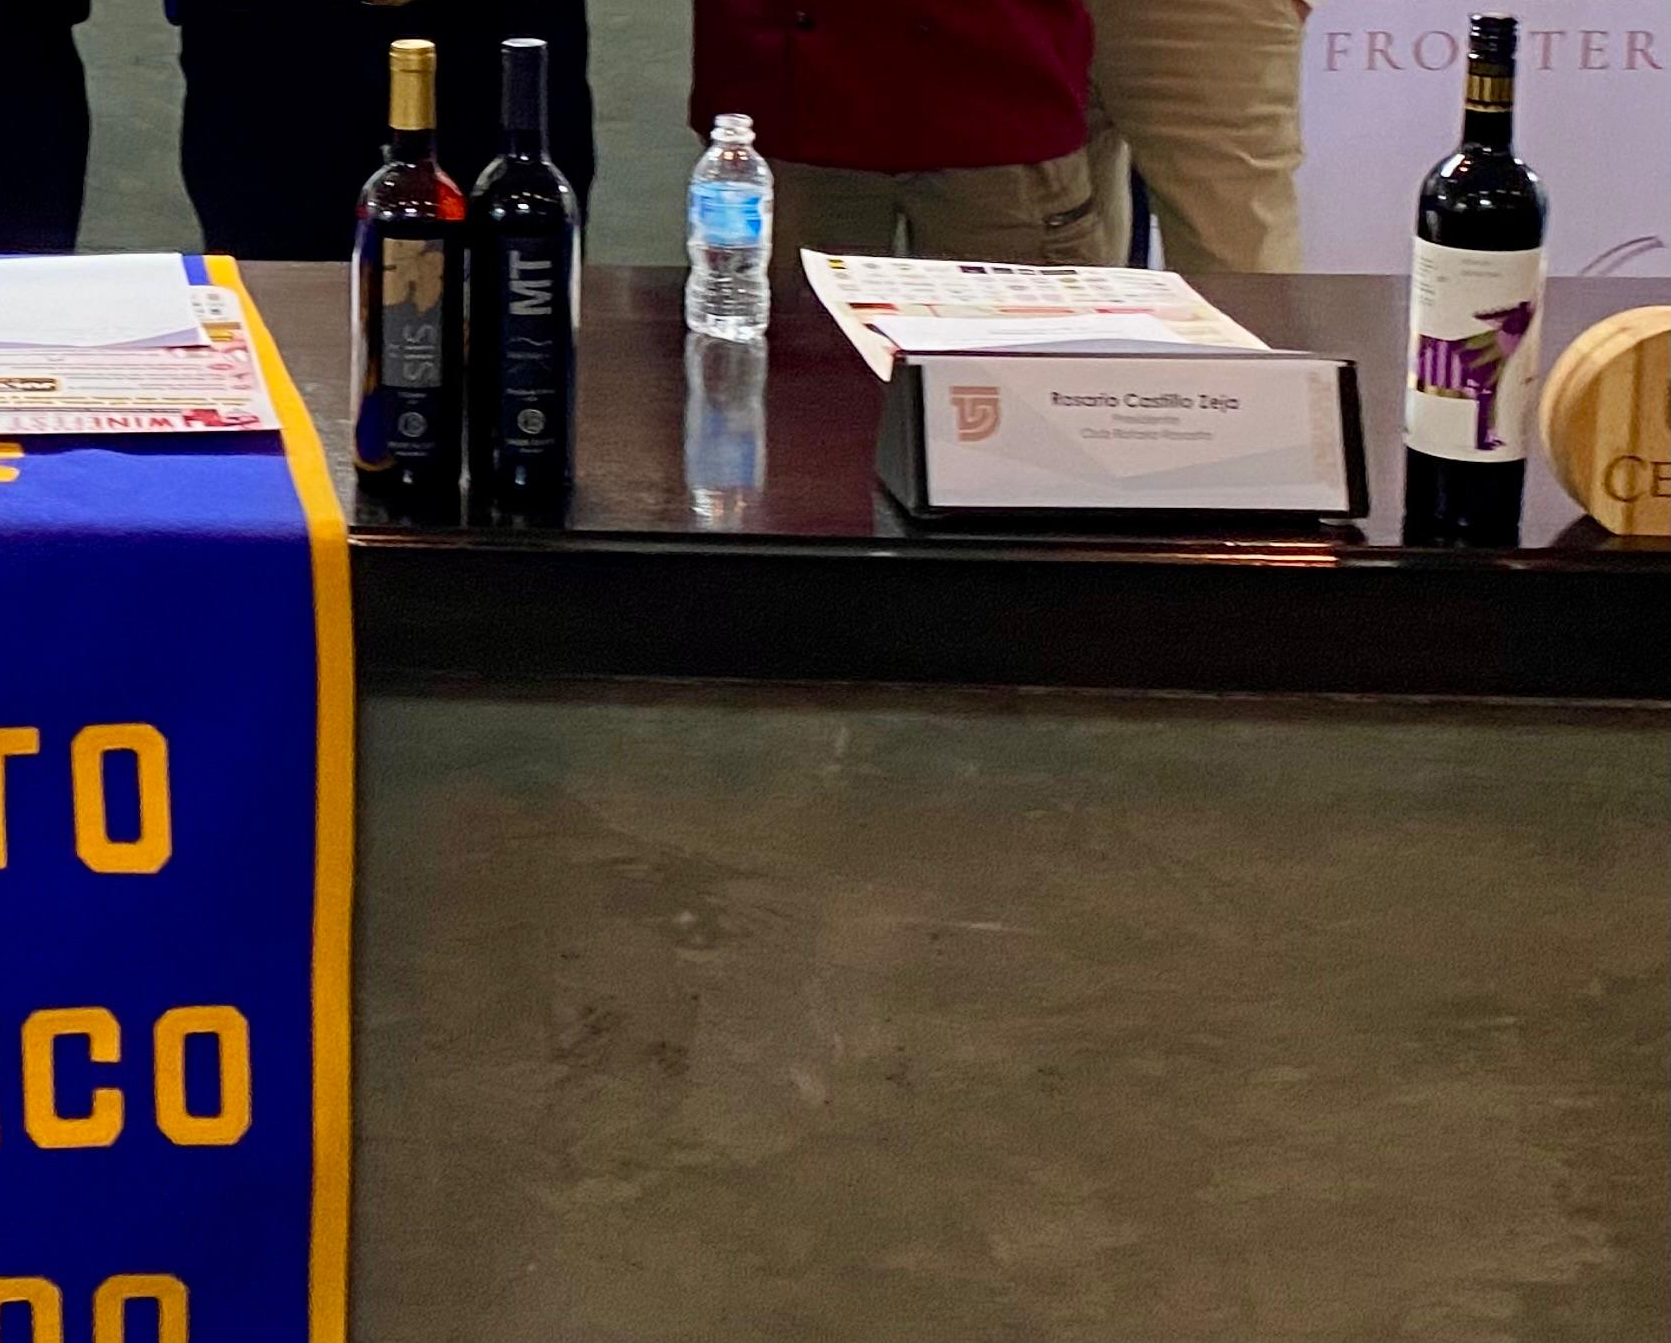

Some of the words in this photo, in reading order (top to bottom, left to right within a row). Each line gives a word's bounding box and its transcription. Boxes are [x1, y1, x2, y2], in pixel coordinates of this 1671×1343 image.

[1323, 30, 1665, 72] FROTER
[508, 249, 553, 316] MT
[1050, 391, 1119, 407] Rosario
[1123, 393, 1195, 409] Castillo
